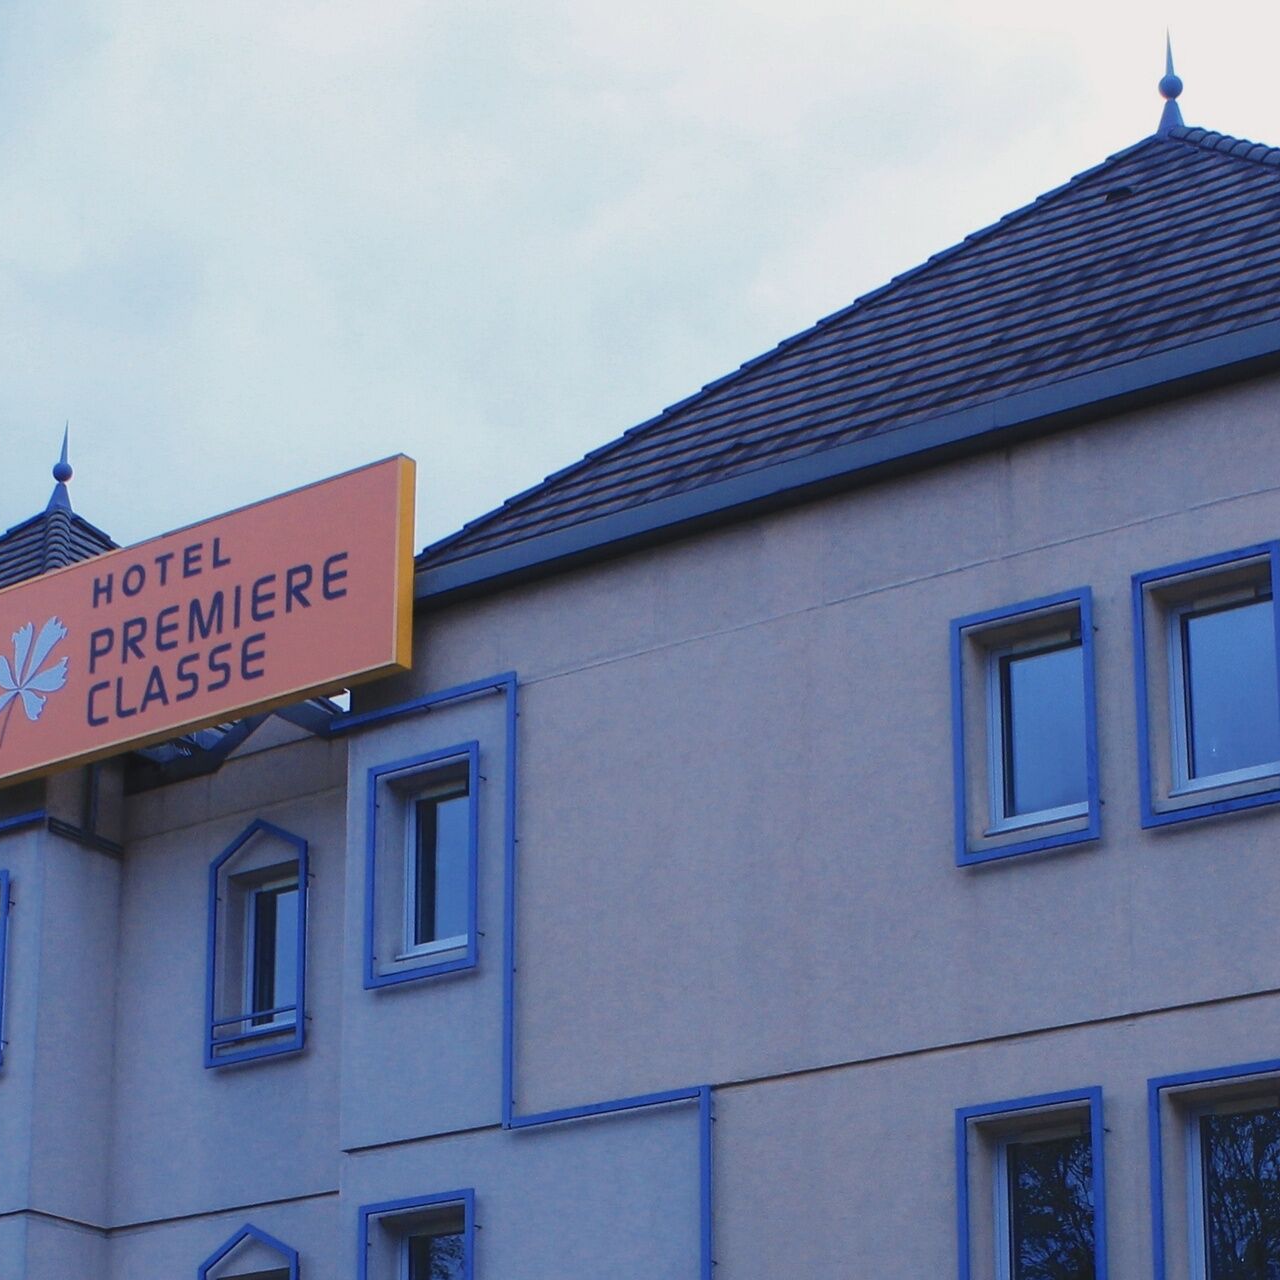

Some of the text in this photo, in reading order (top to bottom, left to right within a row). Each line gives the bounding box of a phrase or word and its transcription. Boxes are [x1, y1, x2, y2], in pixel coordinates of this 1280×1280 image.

[88, 551, 349, 675] PREMIERE
[92, 537, 232, 608] HOTEL
[86, 632, 267, 728] CLASSE
